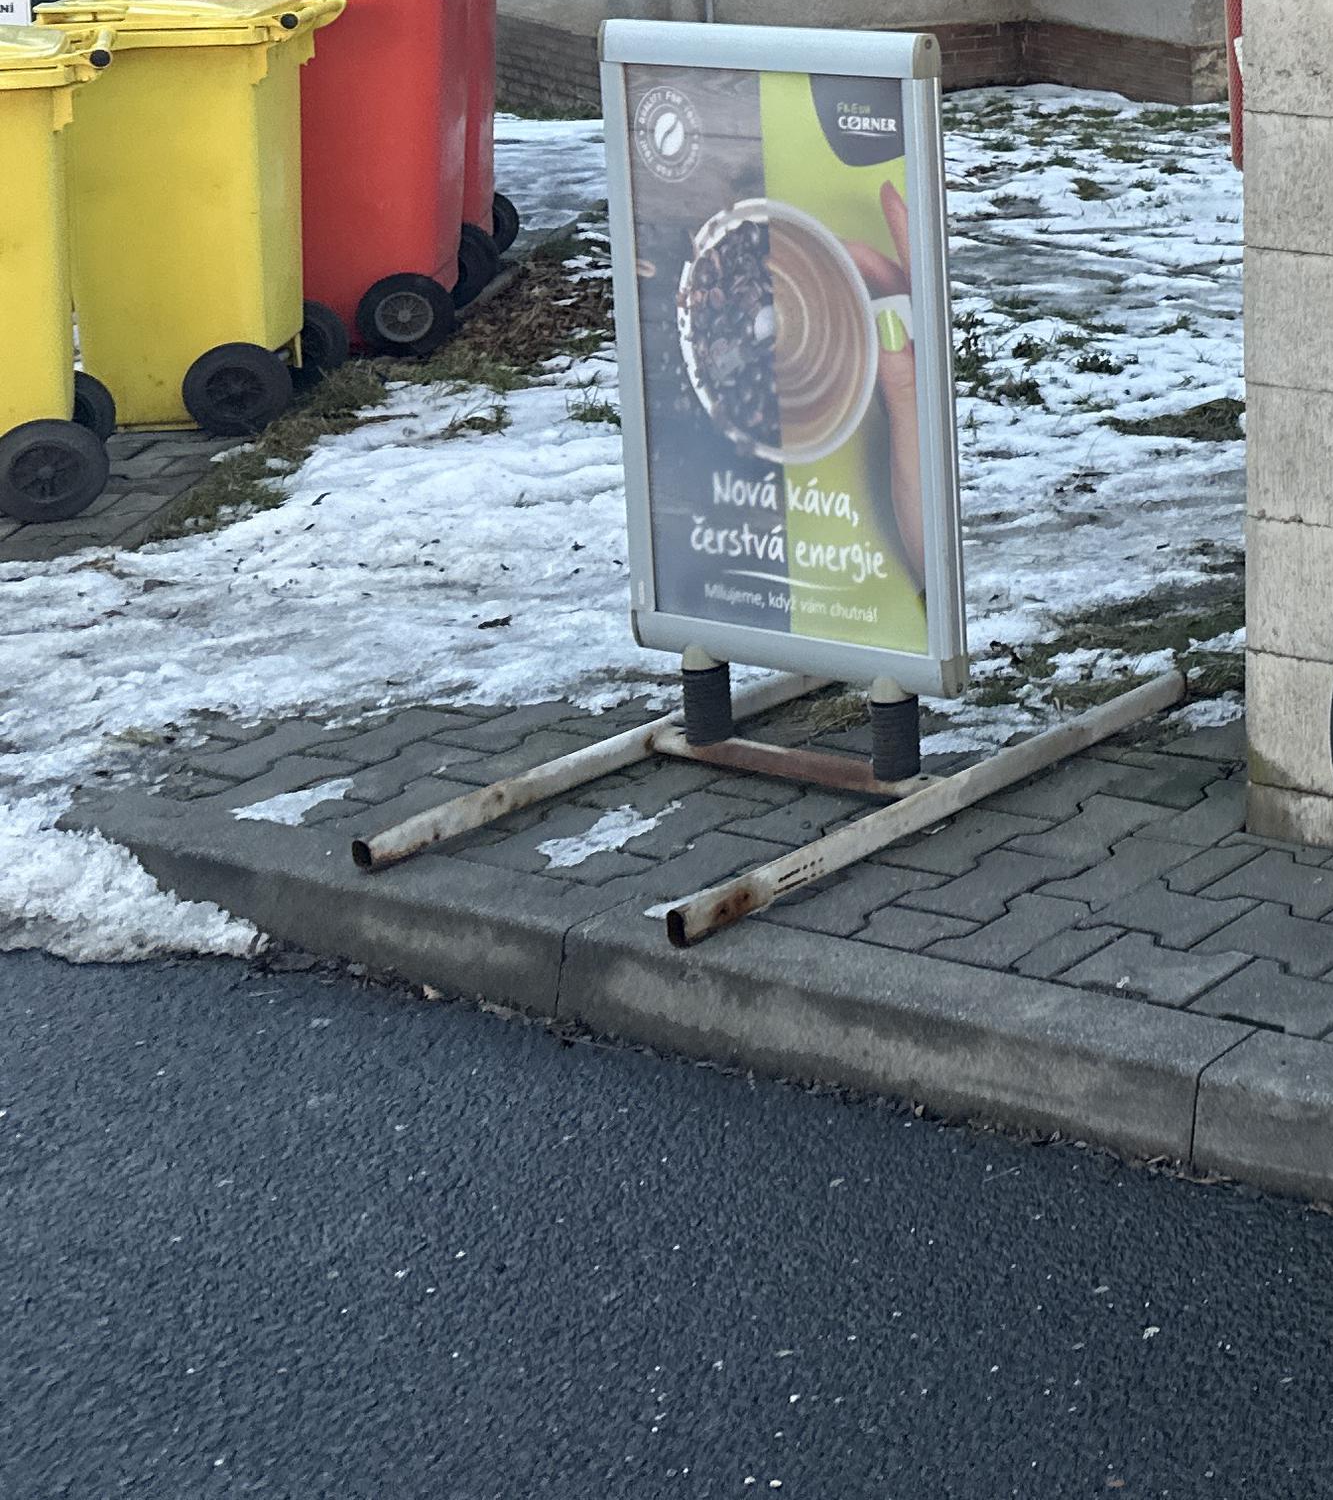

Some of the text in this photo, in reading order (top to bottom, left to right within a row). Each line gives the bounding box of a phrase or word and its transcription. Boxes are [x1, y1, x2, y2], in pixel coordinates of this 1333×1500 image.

[0, 2, 14, 13] NÍ
[838, 115, 897, 132] CORNER
[712, 470, 860, 527] Nová káva,
[690, 515, 888, 584] čerstvá energie
[830, 601, 878, 623] chutná!
